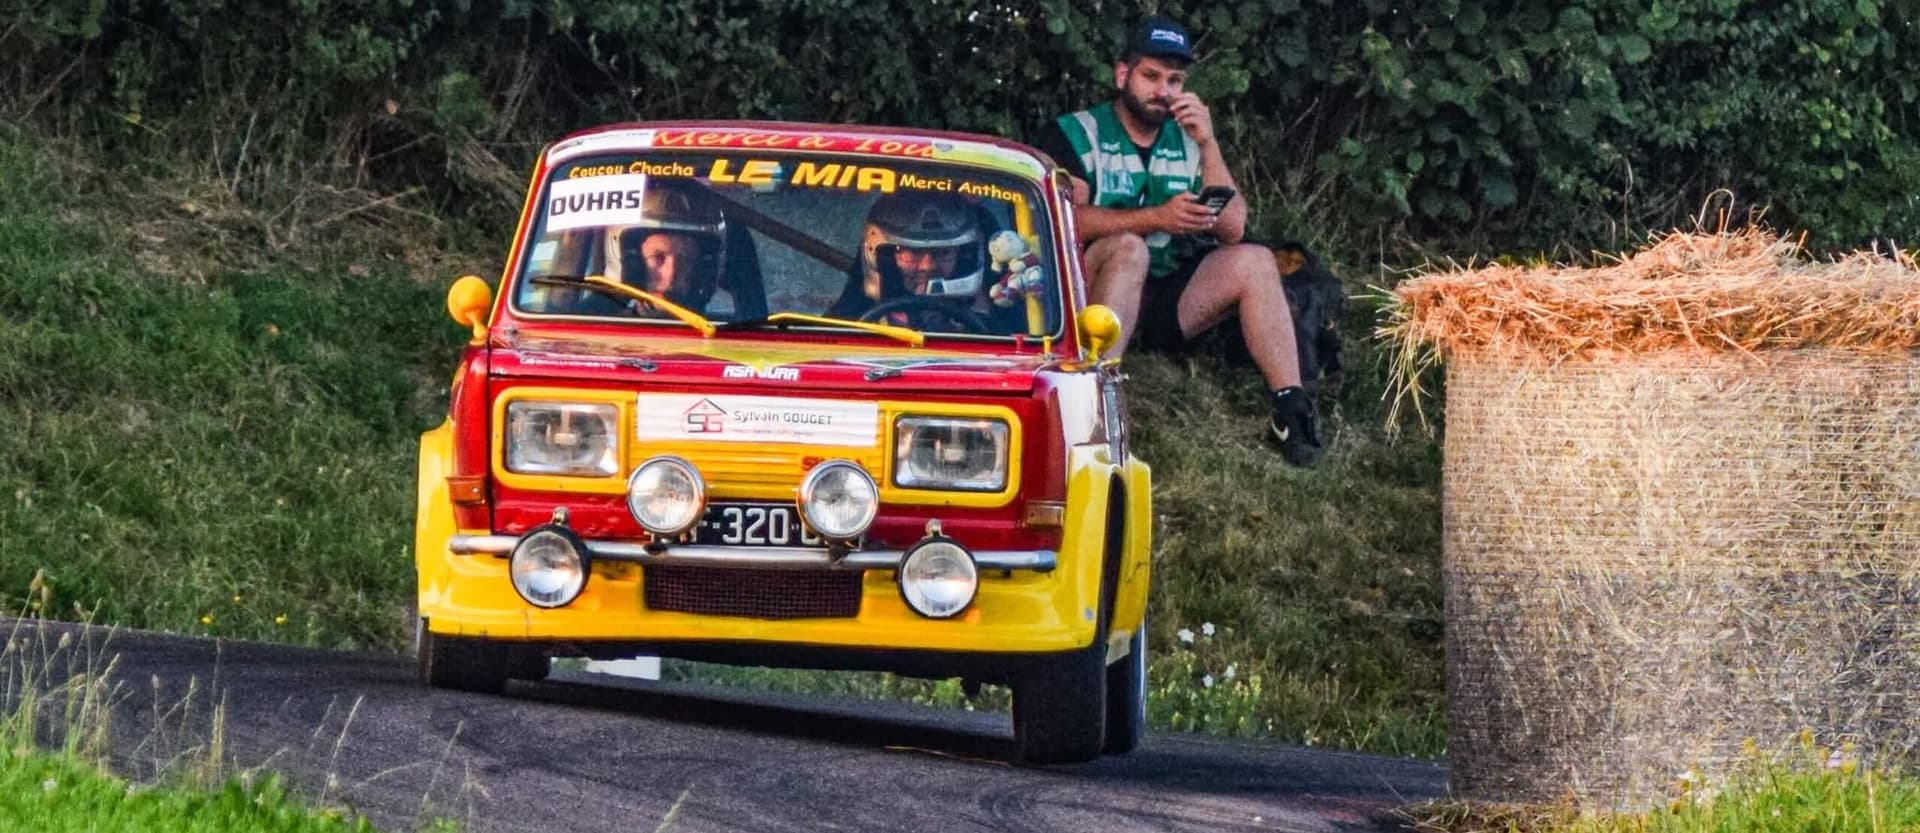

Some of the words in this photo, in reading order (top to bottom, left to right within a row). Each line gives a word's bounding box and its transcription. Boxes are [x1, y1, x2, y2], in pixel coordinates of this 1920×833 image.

[654, 131, 794, 147] Merci
[569, 165, 624, 179] Coucou
[629, 161, 694, 177] Chacha
[708, 159, 781, 184] LE
[791, 162, 897, 194] MIA
[899, 173, 952, 192] Merci
[723, 365, 754, 379] ASA
[734, 411, 780, 423] Sylvain
[783, 412, 833, 426] GOUGET
